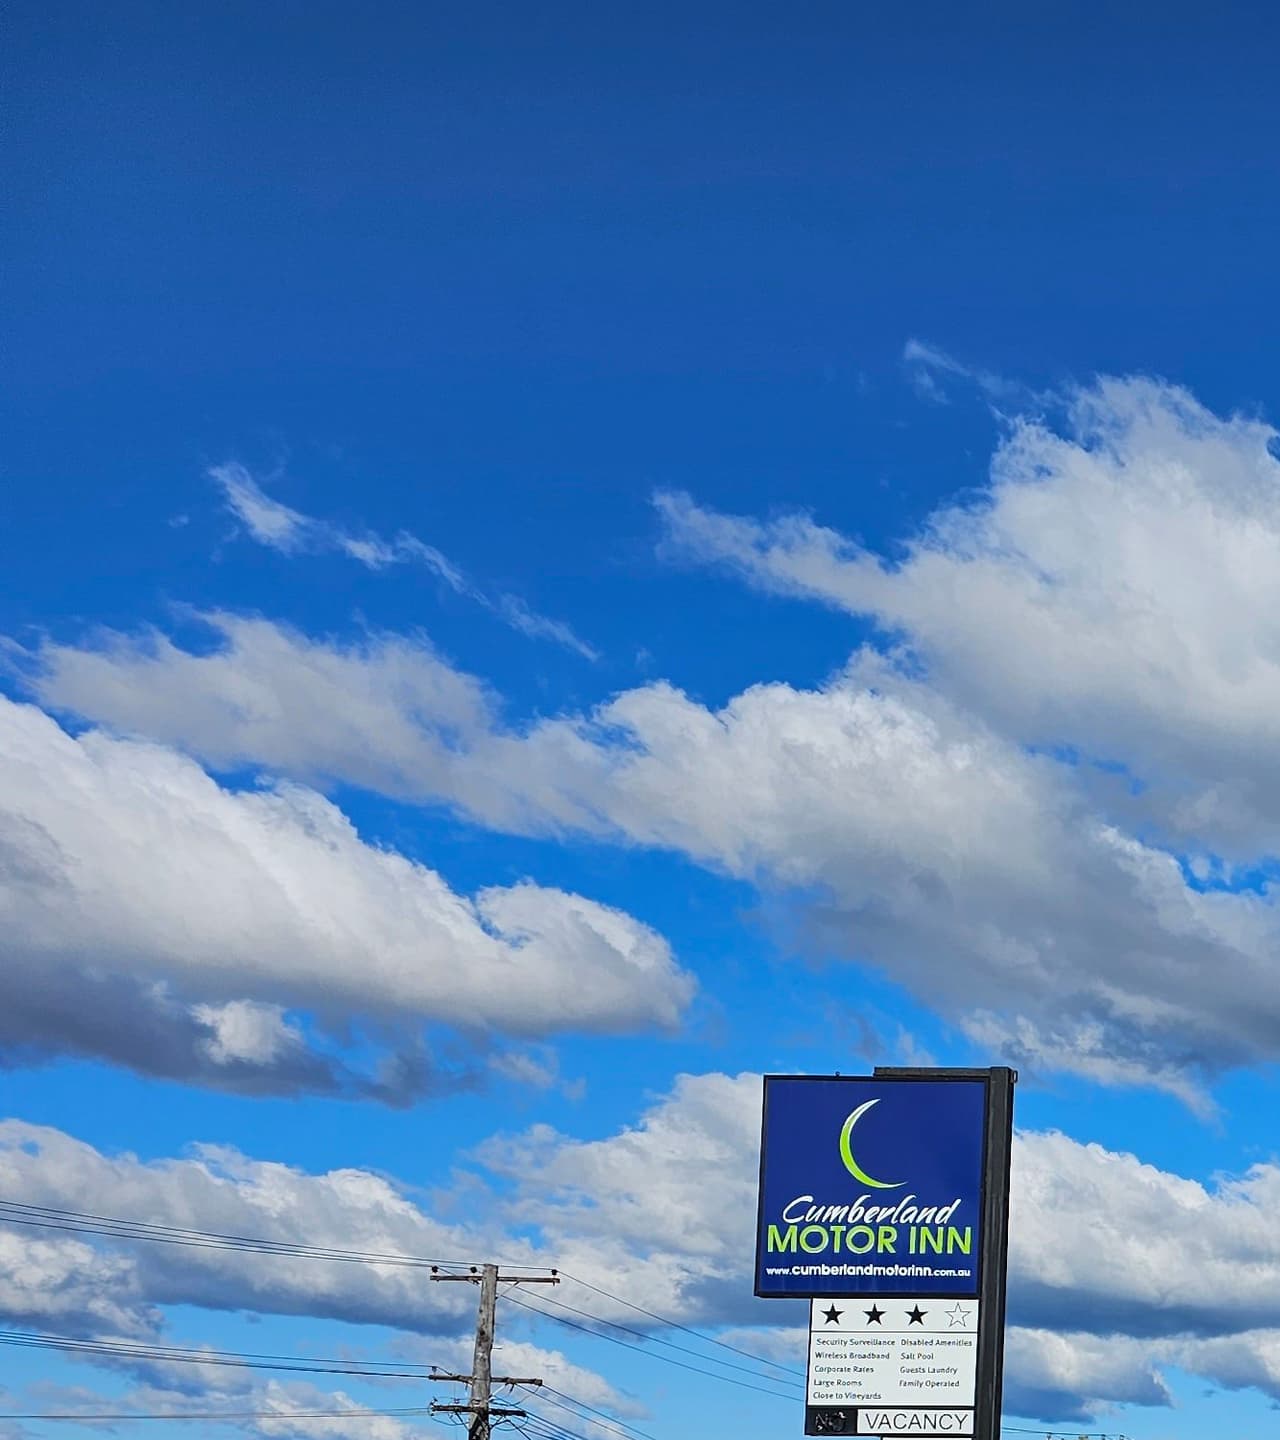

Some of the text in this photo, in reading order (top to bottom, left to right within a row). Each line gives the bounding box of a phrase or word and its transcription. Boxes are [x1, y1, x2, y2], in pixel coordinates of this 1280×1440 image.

[782, 1195, 962, 1224] Cumberland
[767, 1224, 972, 1255] MOTOR INN
[766, 1264, 971, 1277] www.cumberlandmotorinn.com.au
[816, 1338, 896, 1347] Security Surveillance
[900, 1338, 973, 1347] Disabled Amenities
[815, 1351, 890, 1360] Wireless Broadband
[900, 1352, 934, 1360] Salt Pool
[814, 1365, 875, 1374] Corporate Rates
[899, 1366, 958, 1375] Guests Laundry
[813, 1378, 863, 1388] Large Rooms
[898, 1379, 960, 1388] Family Operated
[812, 1391, 882, 1401] Close to Vineyards
[865, 1412, 968, 1431] VACANCY
